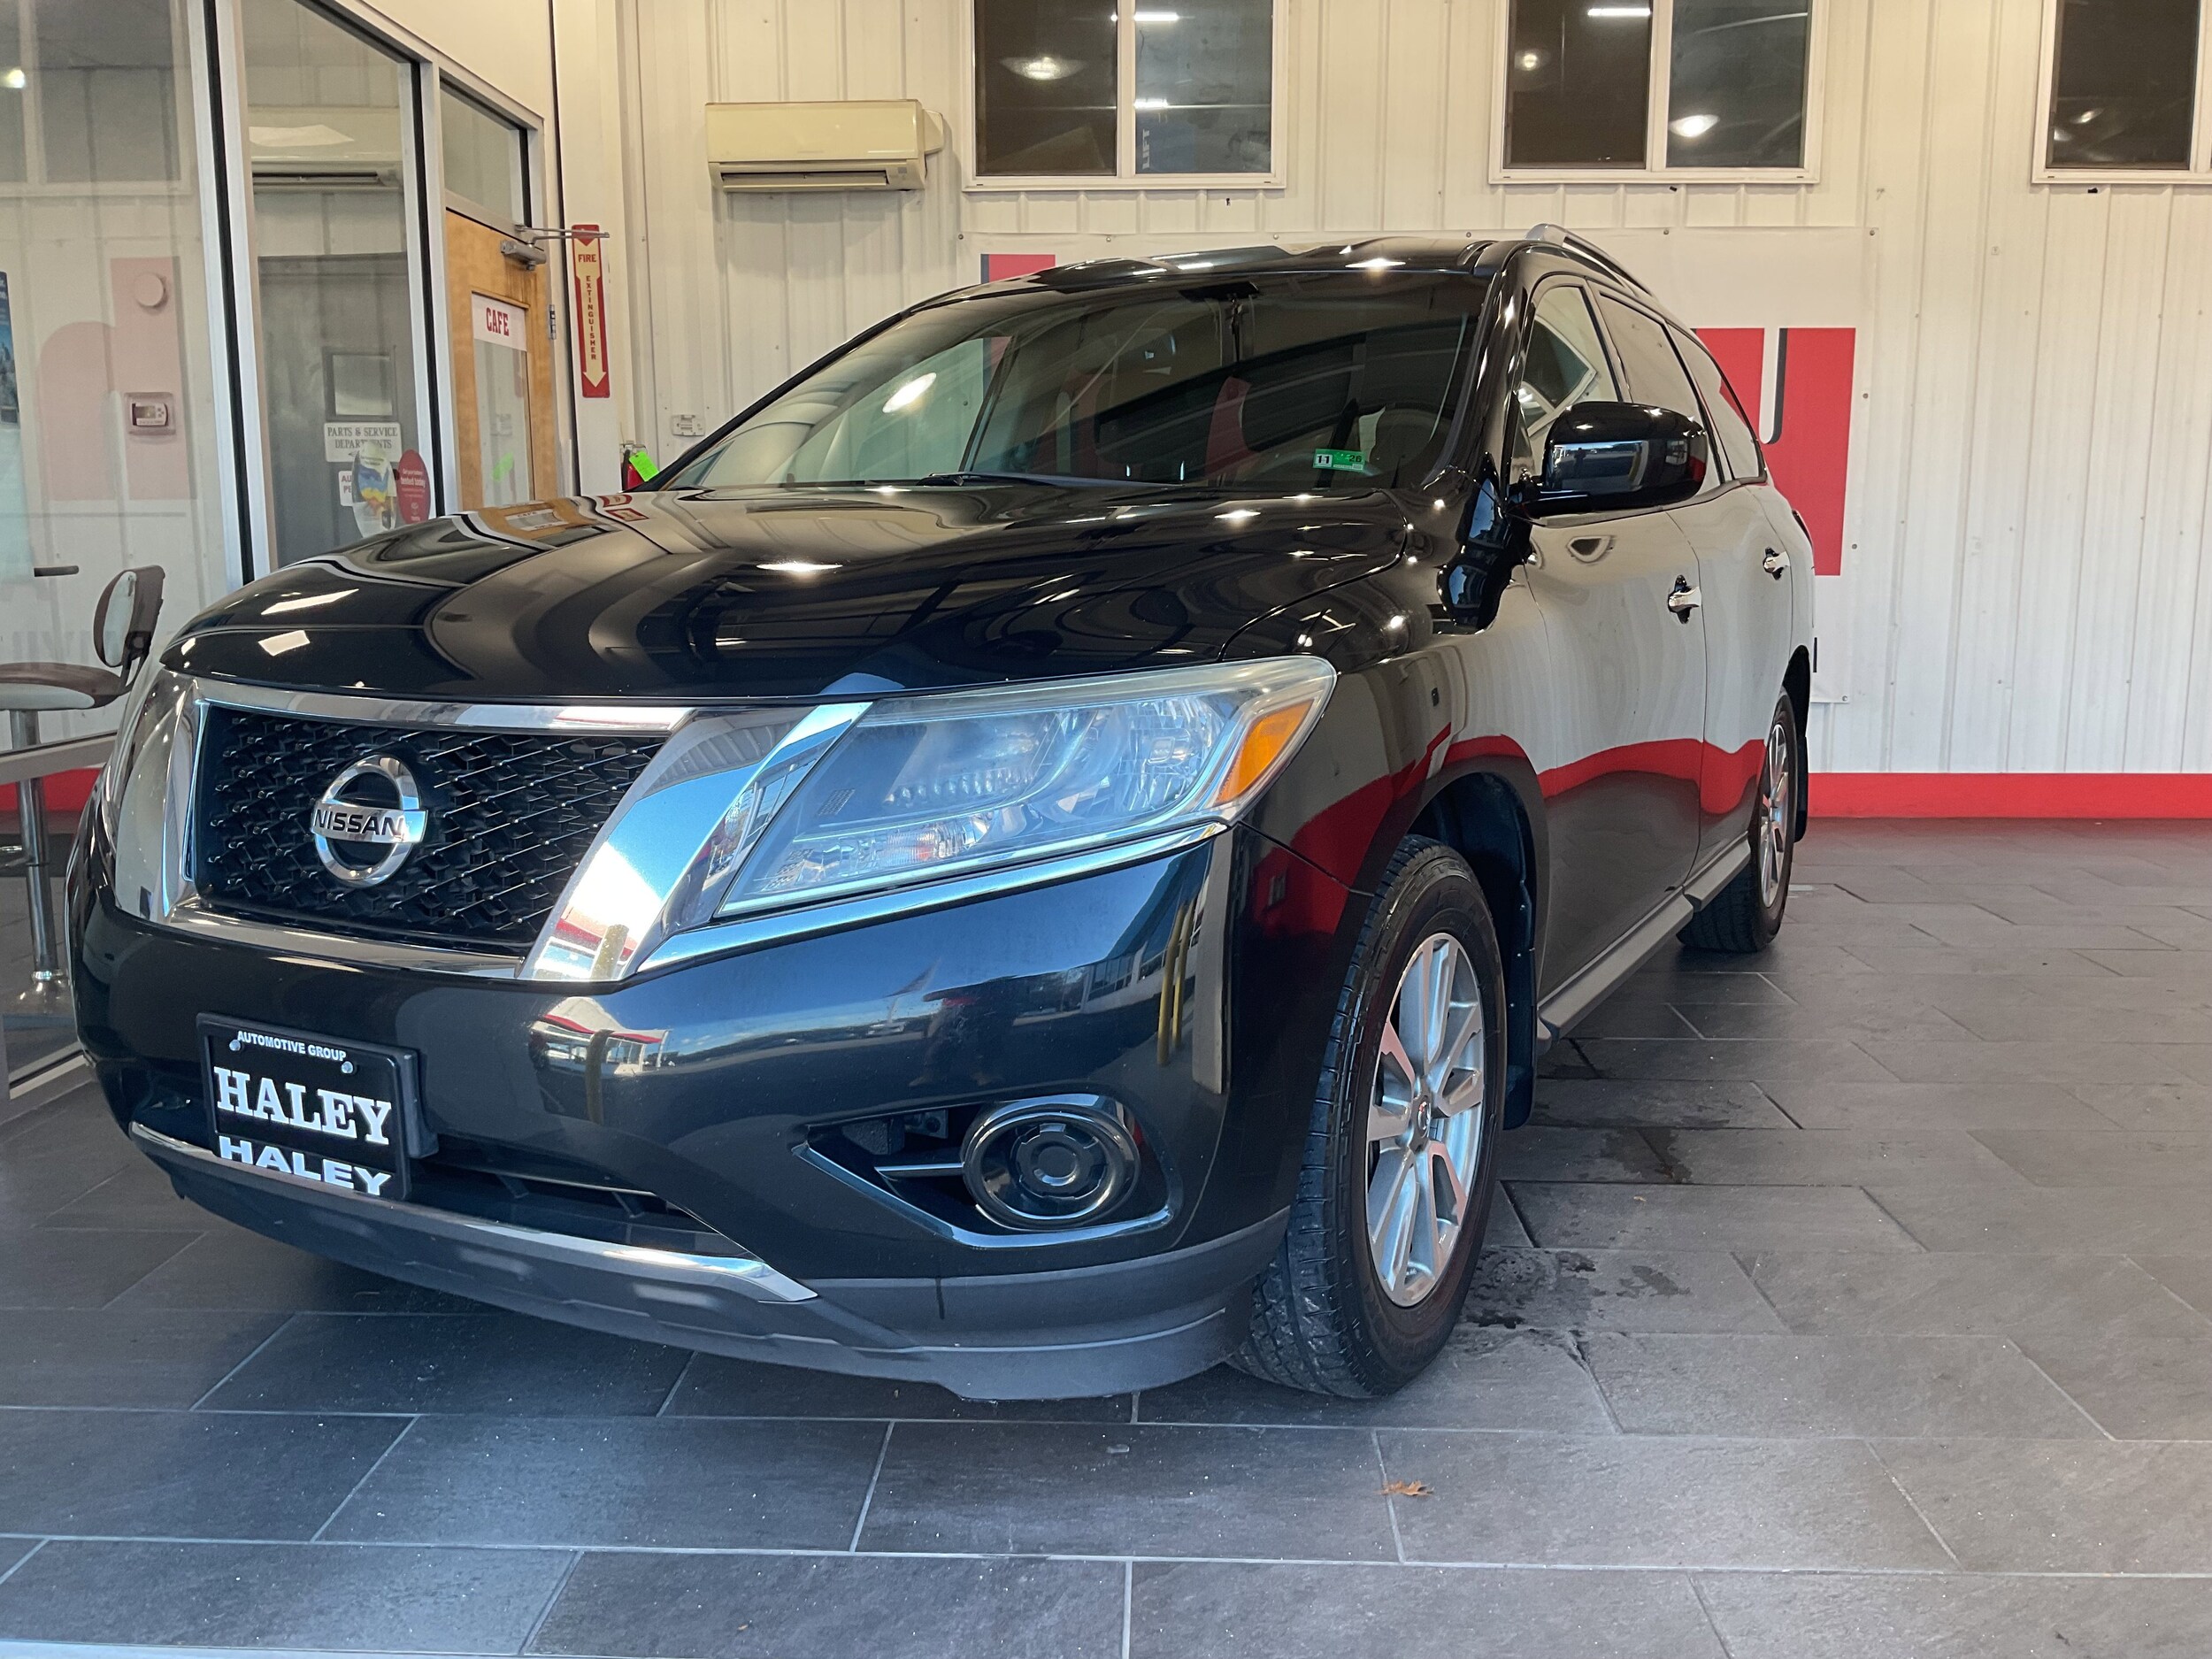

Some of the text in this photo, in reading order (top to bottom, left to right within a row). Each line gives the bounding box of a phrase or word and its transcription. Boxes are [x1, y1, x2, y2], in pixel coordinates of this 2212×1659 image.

[578, 253, 597, 263] FIRE
[486, 307, 510, 337] CAFE
[585, 275, 597, 361] EXTINGUISHER
[327, 426, 398, 437] PARTS & SERVICE
[1317, 455, 1330, 464] 11
[313, 809, 404, 837] NISSAN
[237, 1030, 347, 1062] AUTOMOTIVE GROUP
[213, 1065, 392, 1146] HALEY
[219, 1135, 392, 1196] HALEY
